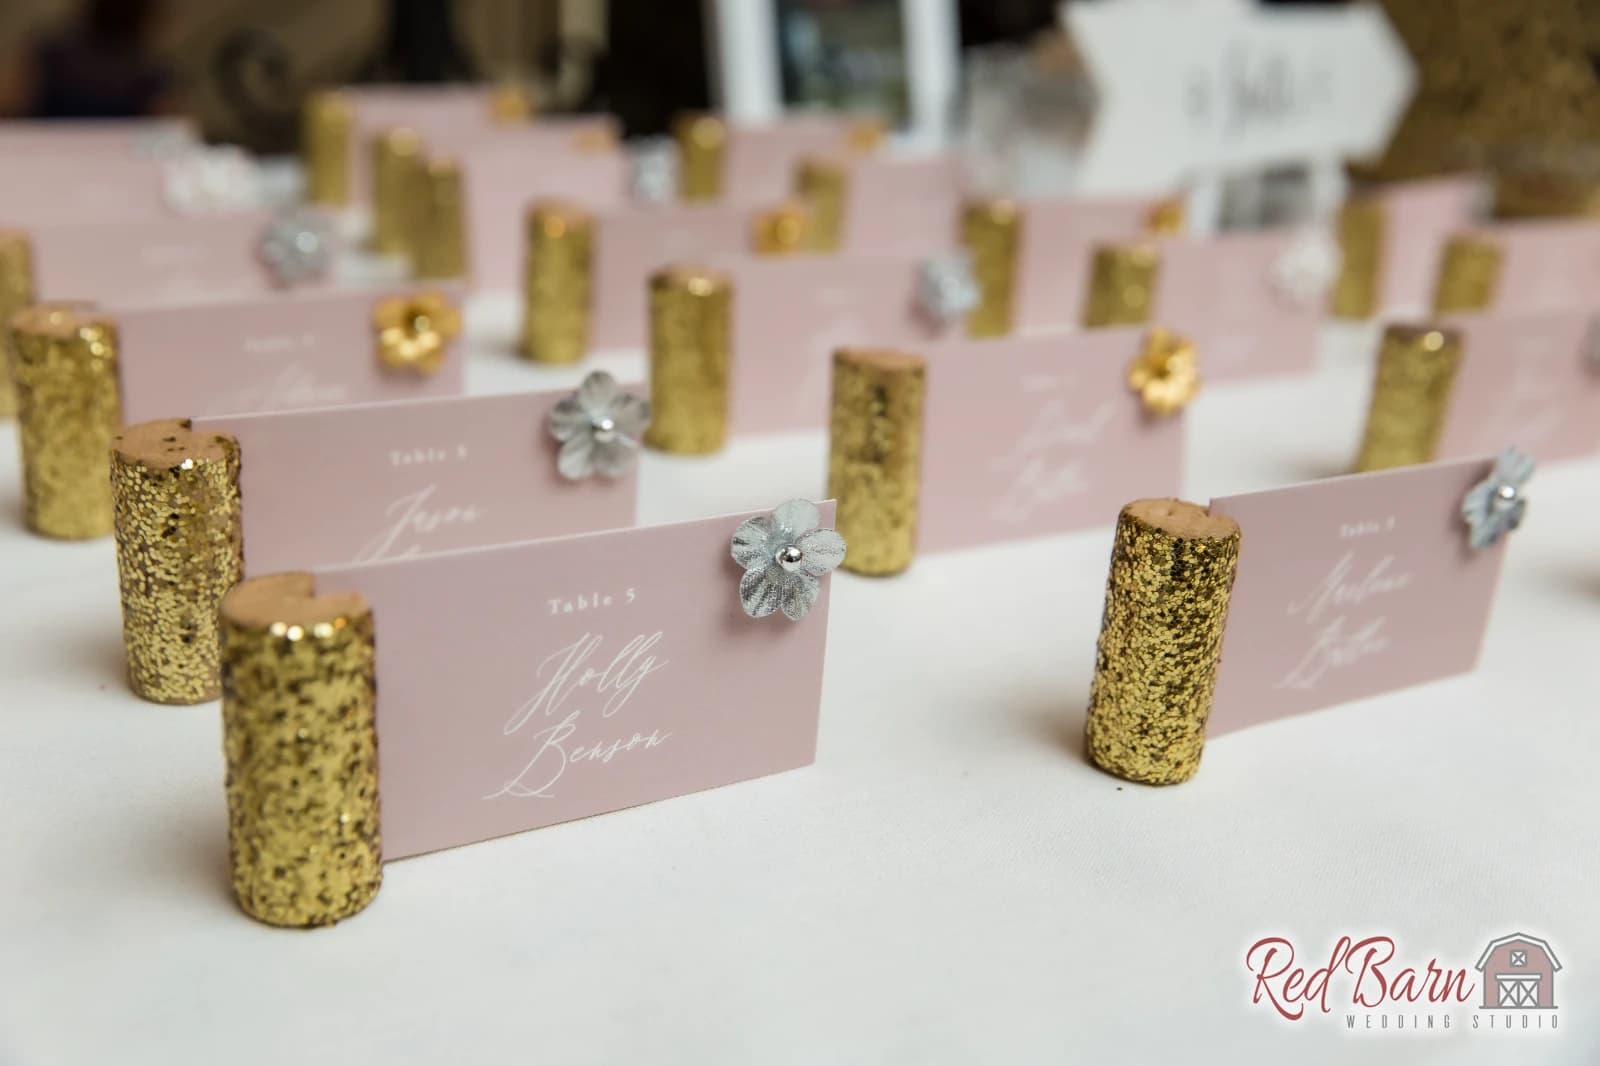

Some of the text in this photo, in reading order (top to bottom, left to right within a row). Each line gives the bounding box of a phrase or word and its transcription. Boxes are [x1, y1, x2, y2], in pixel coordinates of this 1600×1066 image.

[548, 587, 636, 614] Table 5
[503, 631, 670, 735] Holly
[481, 709, 672, 799] Benson
